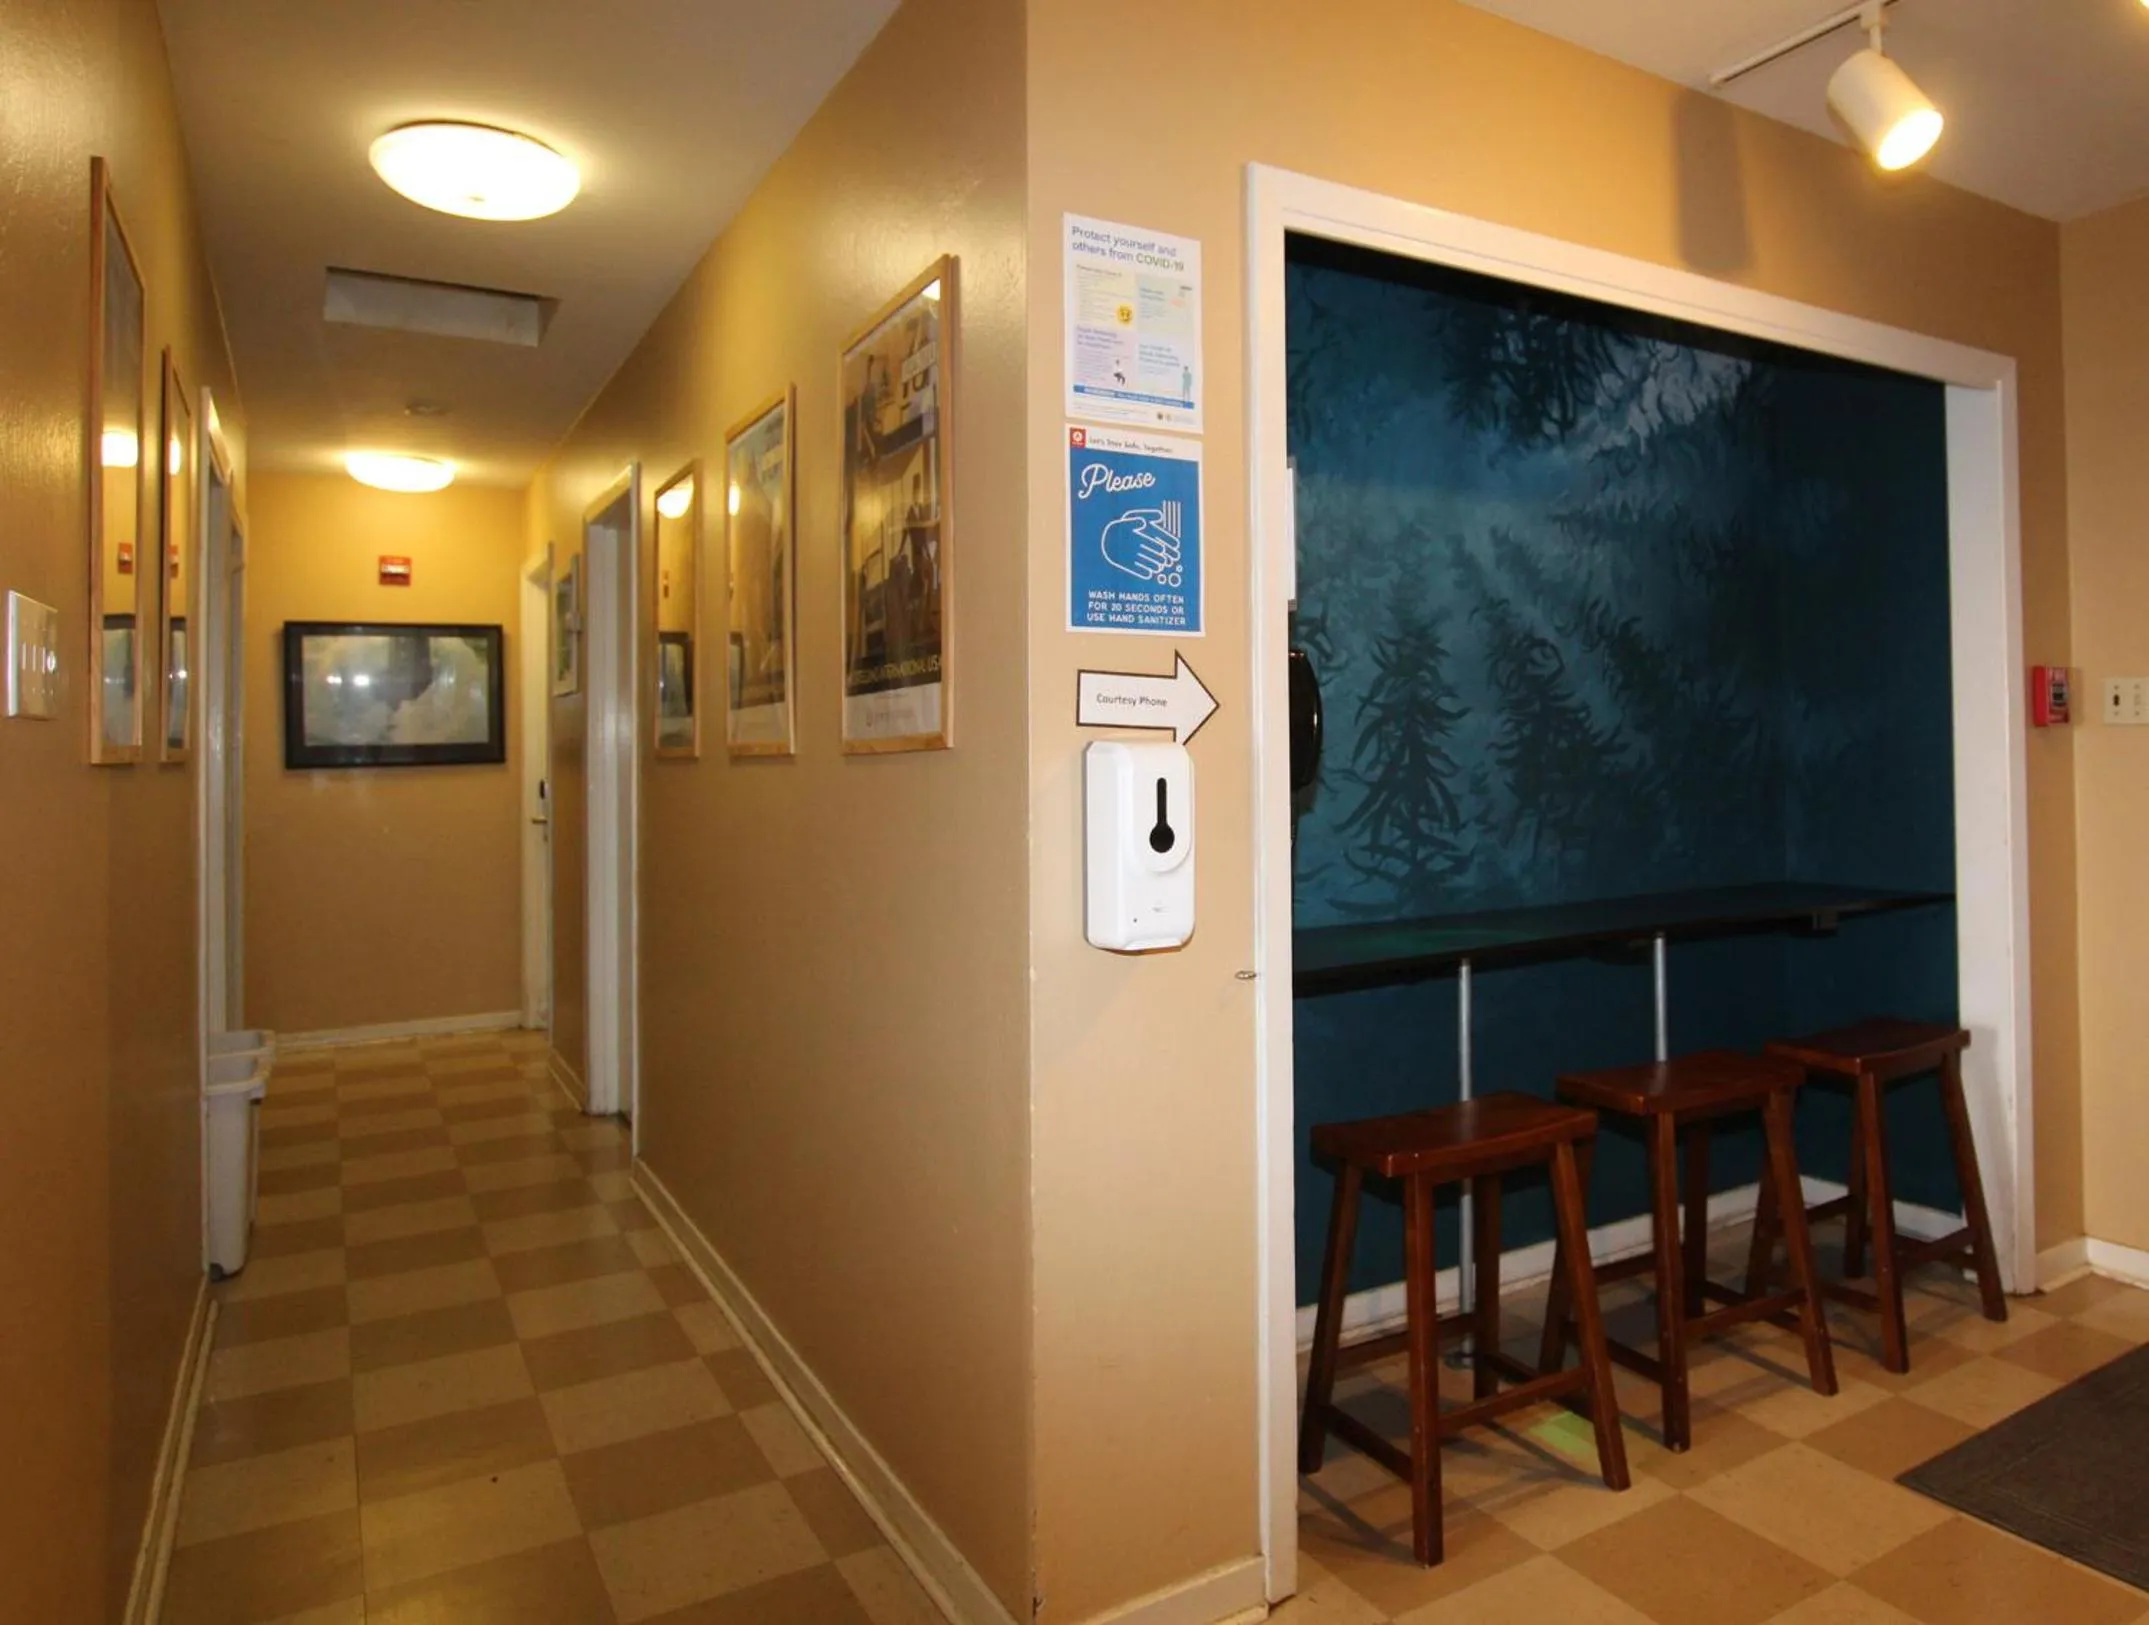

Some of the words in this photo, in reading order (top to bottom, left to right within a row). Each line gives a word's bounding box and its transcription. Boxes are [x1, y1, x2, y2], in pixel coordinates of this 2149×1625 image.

[1072, 225, 1110, 243] Protect
[1113, 236, 1155, 251] yourself
[1158, 246, 1177, 257] and
[1072, 241, 1107, 256] others
[1109, 247, 1134, 261] from
[1135, 252, 1184, 271] COVID-19
[1078, 463, 1156, 499] Please
[1088, 590, 1115, 600] WASH
[1118, 592, 1150, 602] HANDS
[1153, 594, 1185, 605] OFTEN
[1088, 601, 1107, 611] FOR
[1111, 603, 1122, 612] 20
[1125, 604, 1168, 614] SECONDS
[1171, 605, 1185, 615] OR
[1087, 613, 1105, 622] USE
[1108, 614, 1135, 623] HAND
[1138, 615, 1186, 625] SANITIZER
[1096, 692, 1137, 706] Courtesy
[1138, 696, 1168, 707] Phone
